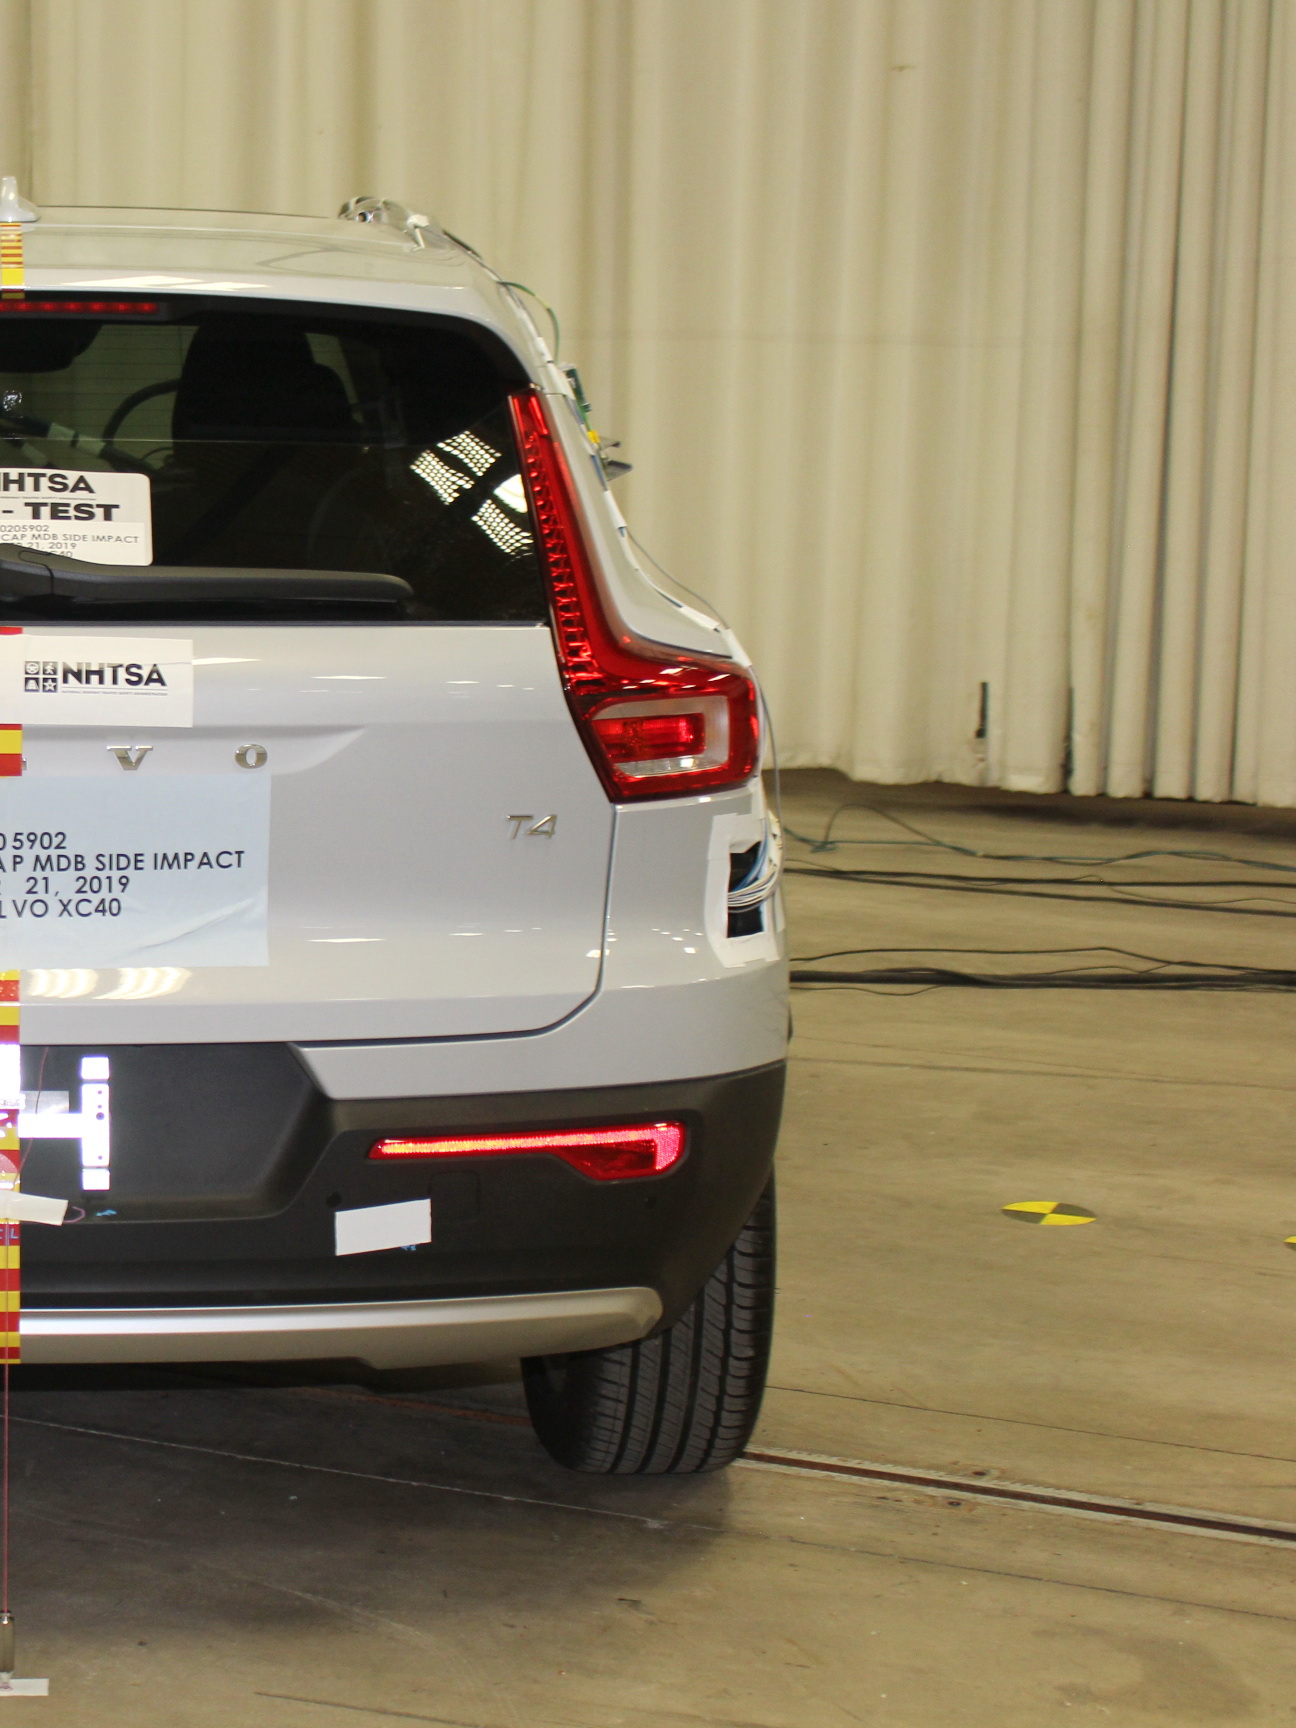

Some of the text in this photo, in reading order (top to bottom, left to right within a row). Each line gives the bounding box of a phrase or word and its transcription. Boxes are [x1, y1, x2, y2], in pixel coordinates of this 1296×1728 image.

[24, 502, 120, 521] TEST
[31, 533, 58, 541] MDB
[62, 534, 88, 542] SIDE
[92, 535, 139, 543] IMPACT
[62, 662, 167, 687] NHTSA
[506, 814, 557, 840] T4
[33, 854, 86, 872] MDB
[95, 853, 145, 872] SIDE
[154, 850, 245, 870] IMPACT
[25, 876, 60, 897] 21,
[75, 875, 130, 894] 2019
[58, 898, 121, 917] XC40
